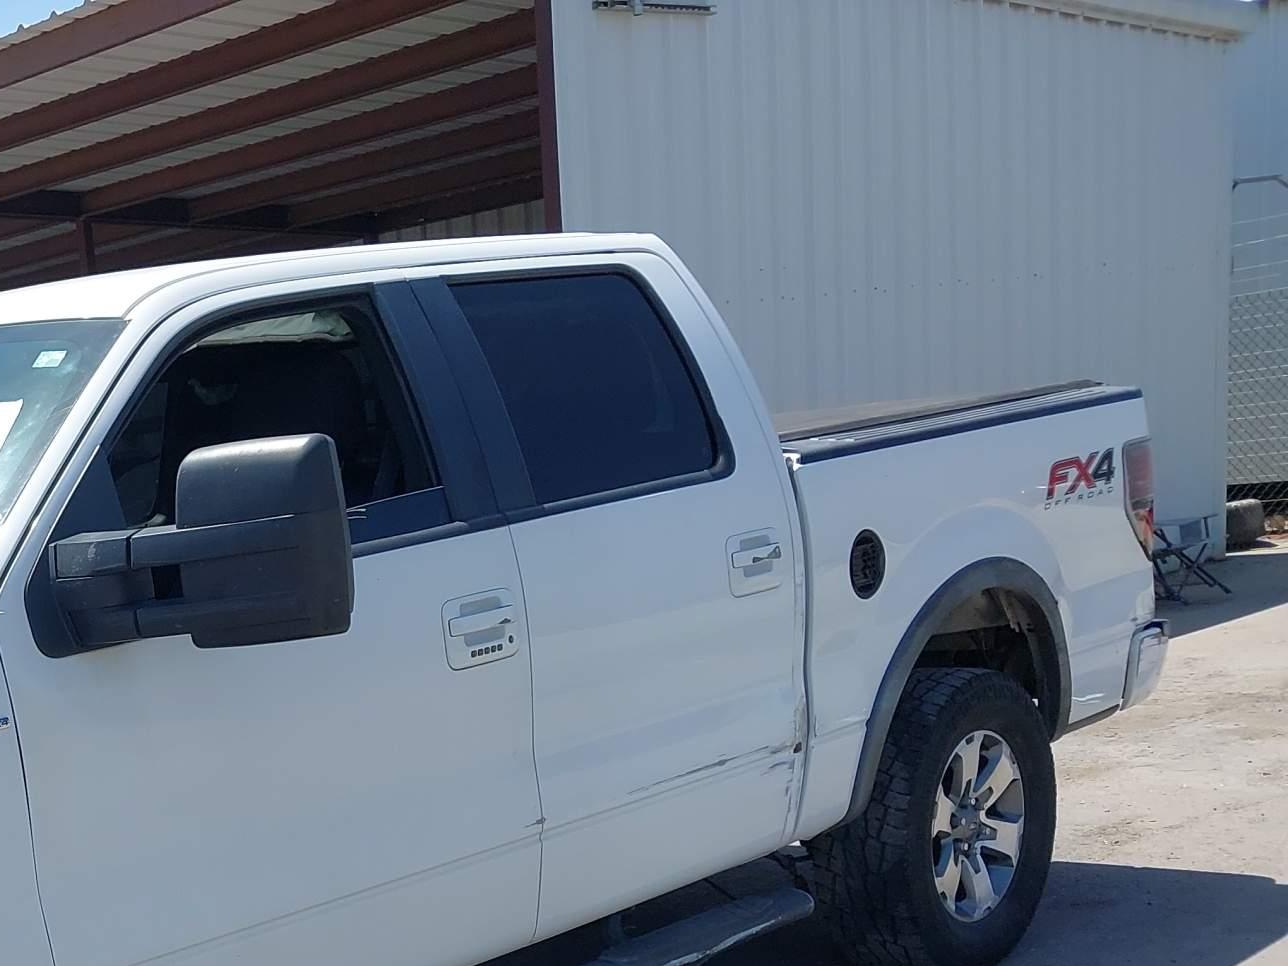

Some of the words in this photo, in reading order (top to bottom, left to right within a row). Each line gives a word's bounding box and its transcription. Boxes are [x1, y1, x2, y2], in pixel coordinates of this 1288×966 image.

[1046, 447, 1116, 501] FX4
[1044, 497, 1071, 511] OFF
[1077, 486, 1114, 500] ROAD
